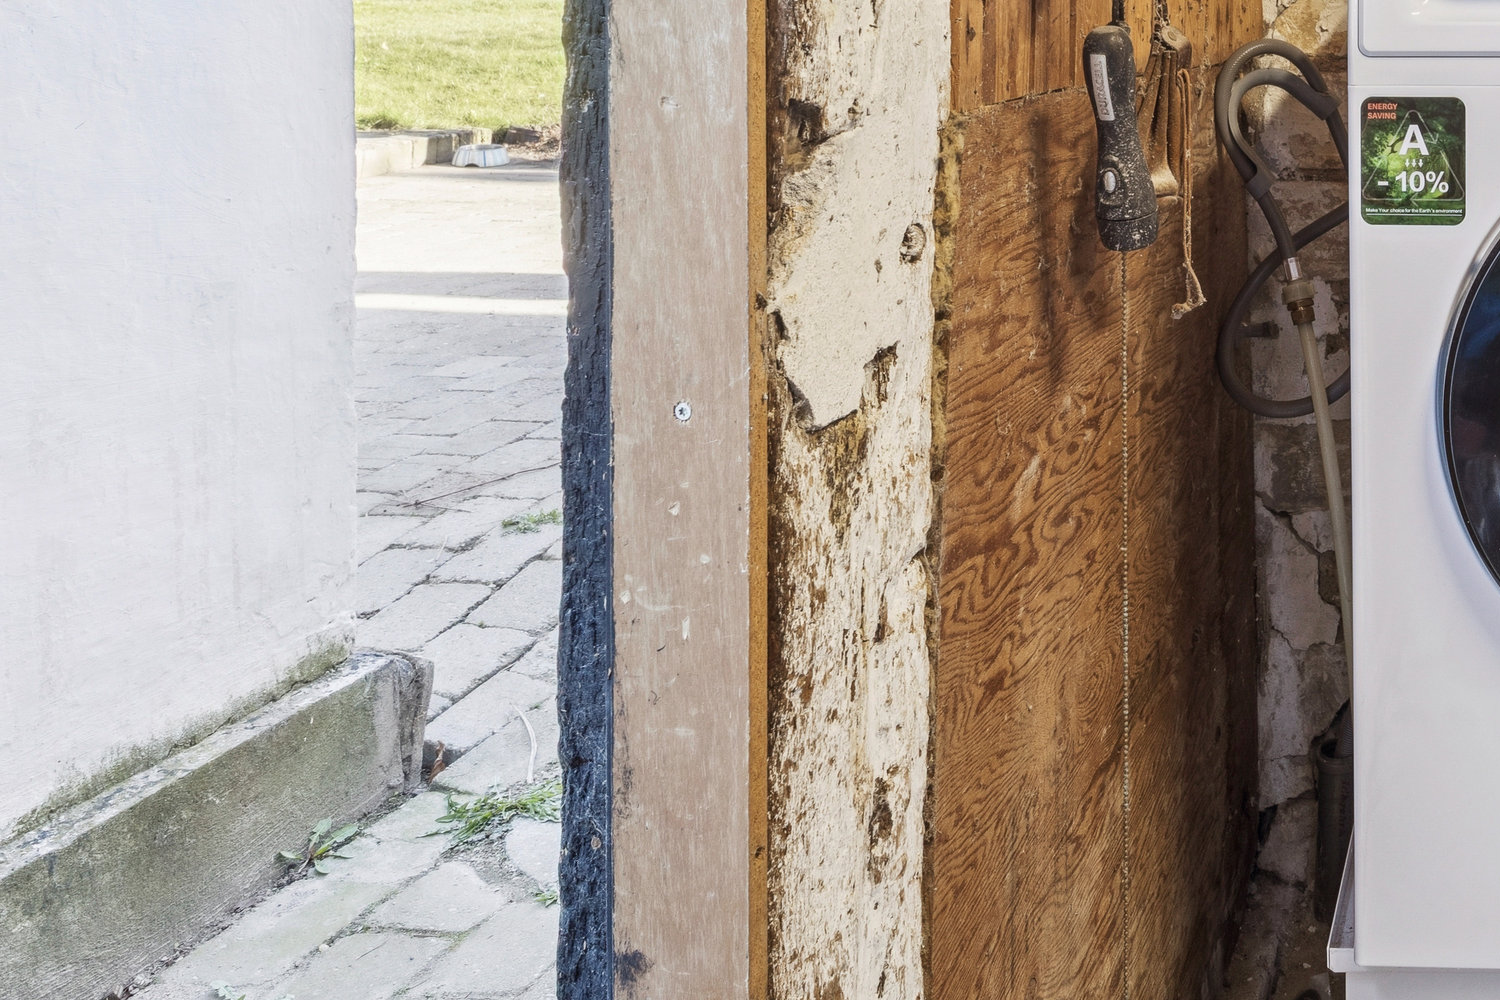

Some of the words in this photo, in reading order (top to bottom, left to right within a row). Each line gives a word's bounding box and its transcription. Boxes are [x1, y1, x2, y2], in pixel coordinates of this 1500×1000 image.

[1367, 103, 1398, 111] ENERGY
[1367, 112, 1397, 120] SAVING
[1399, 124, 1430, 156] A
